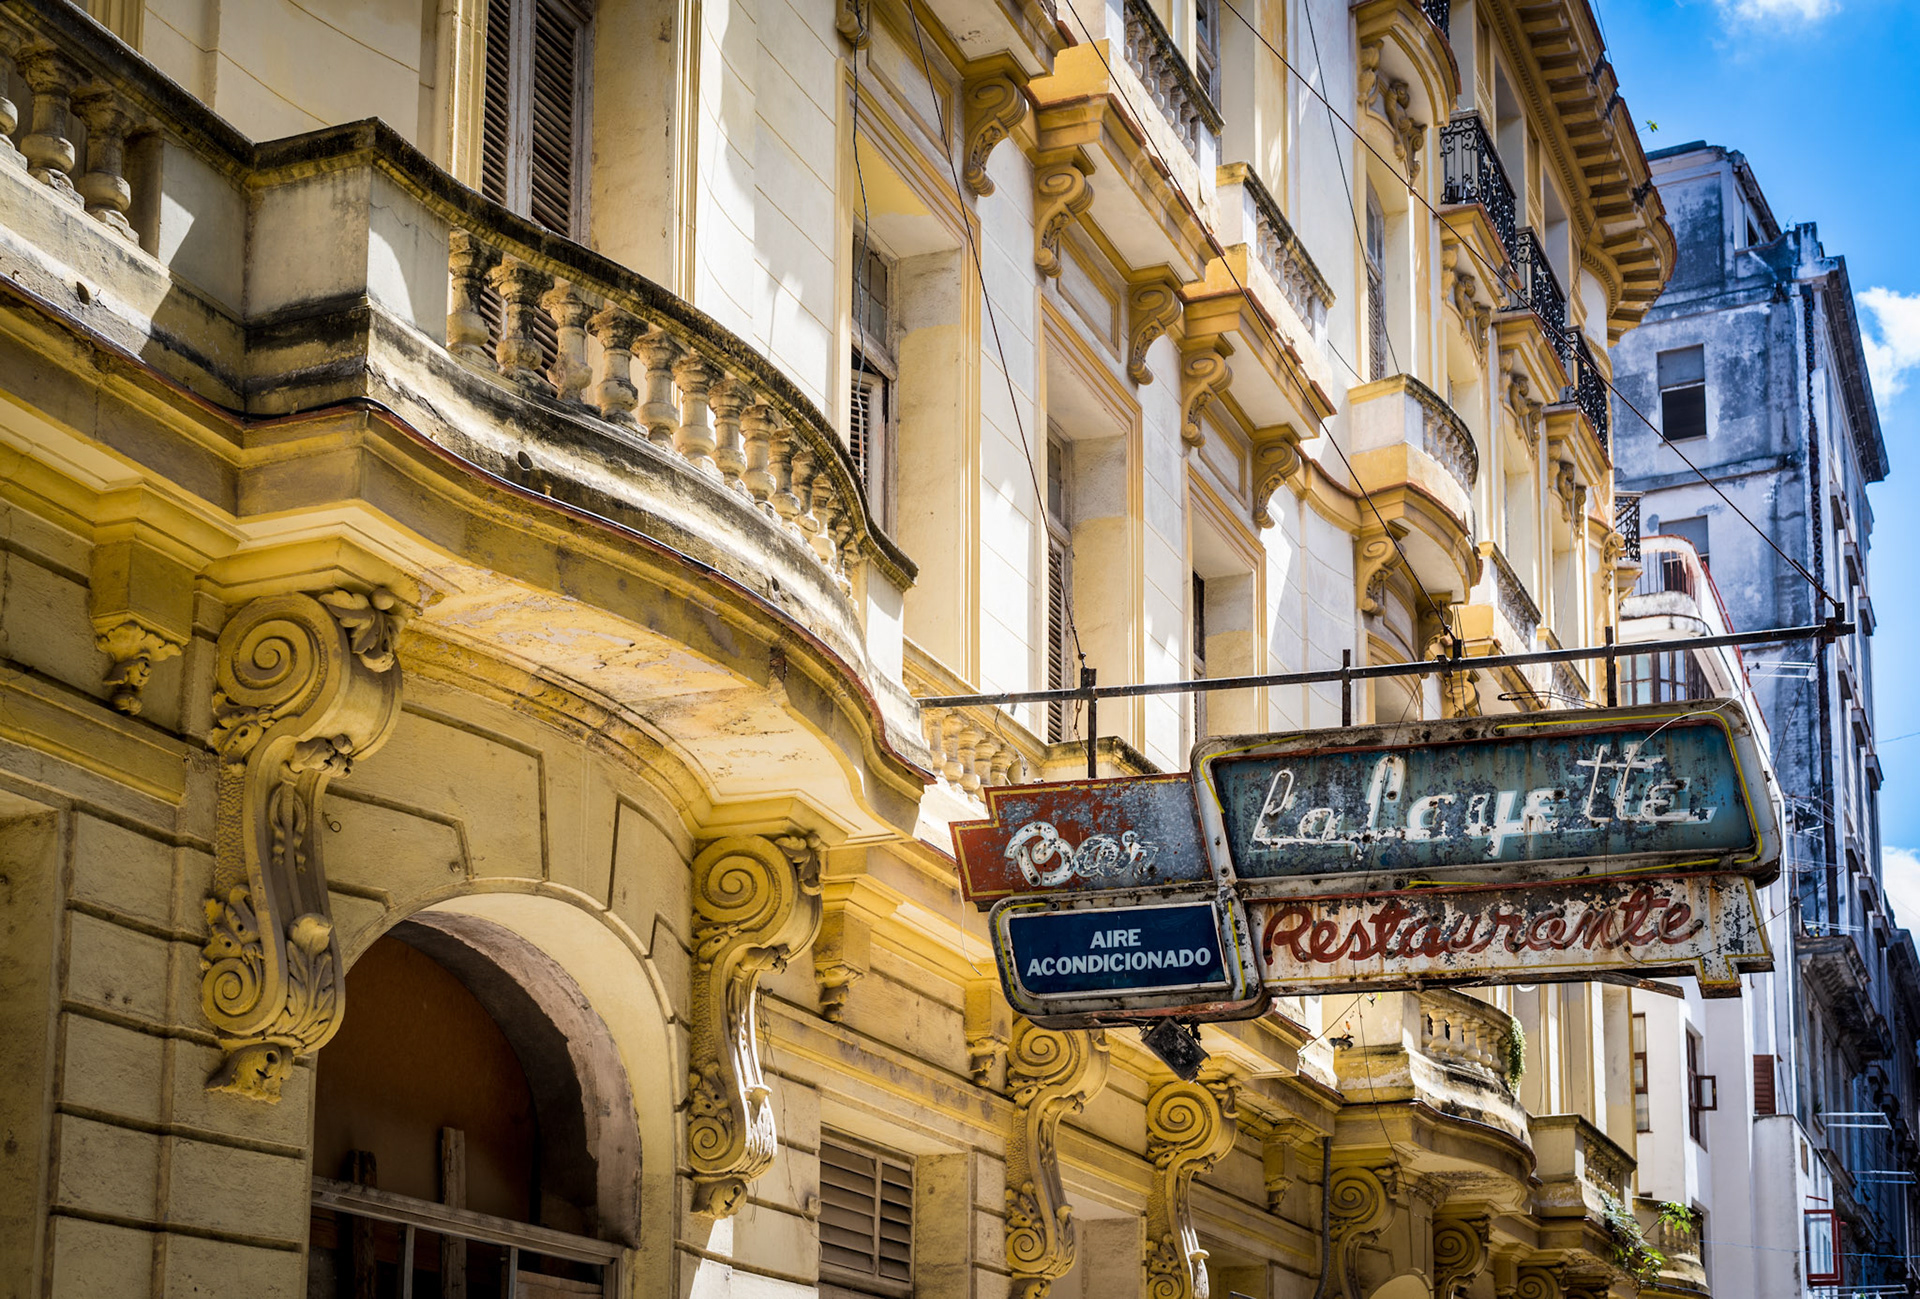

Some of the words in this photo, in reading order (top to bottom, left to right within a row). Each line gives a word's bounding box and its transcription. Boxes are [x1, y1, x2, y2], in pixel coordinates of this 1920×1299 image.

[1004, 821, 1159, 887] Bar
[1089, 928, 1142, 949] AIRE
[1263, 884, 1704, 965] Restaurante
[1027, 947, 1212, 976] ACONDICIONADO
